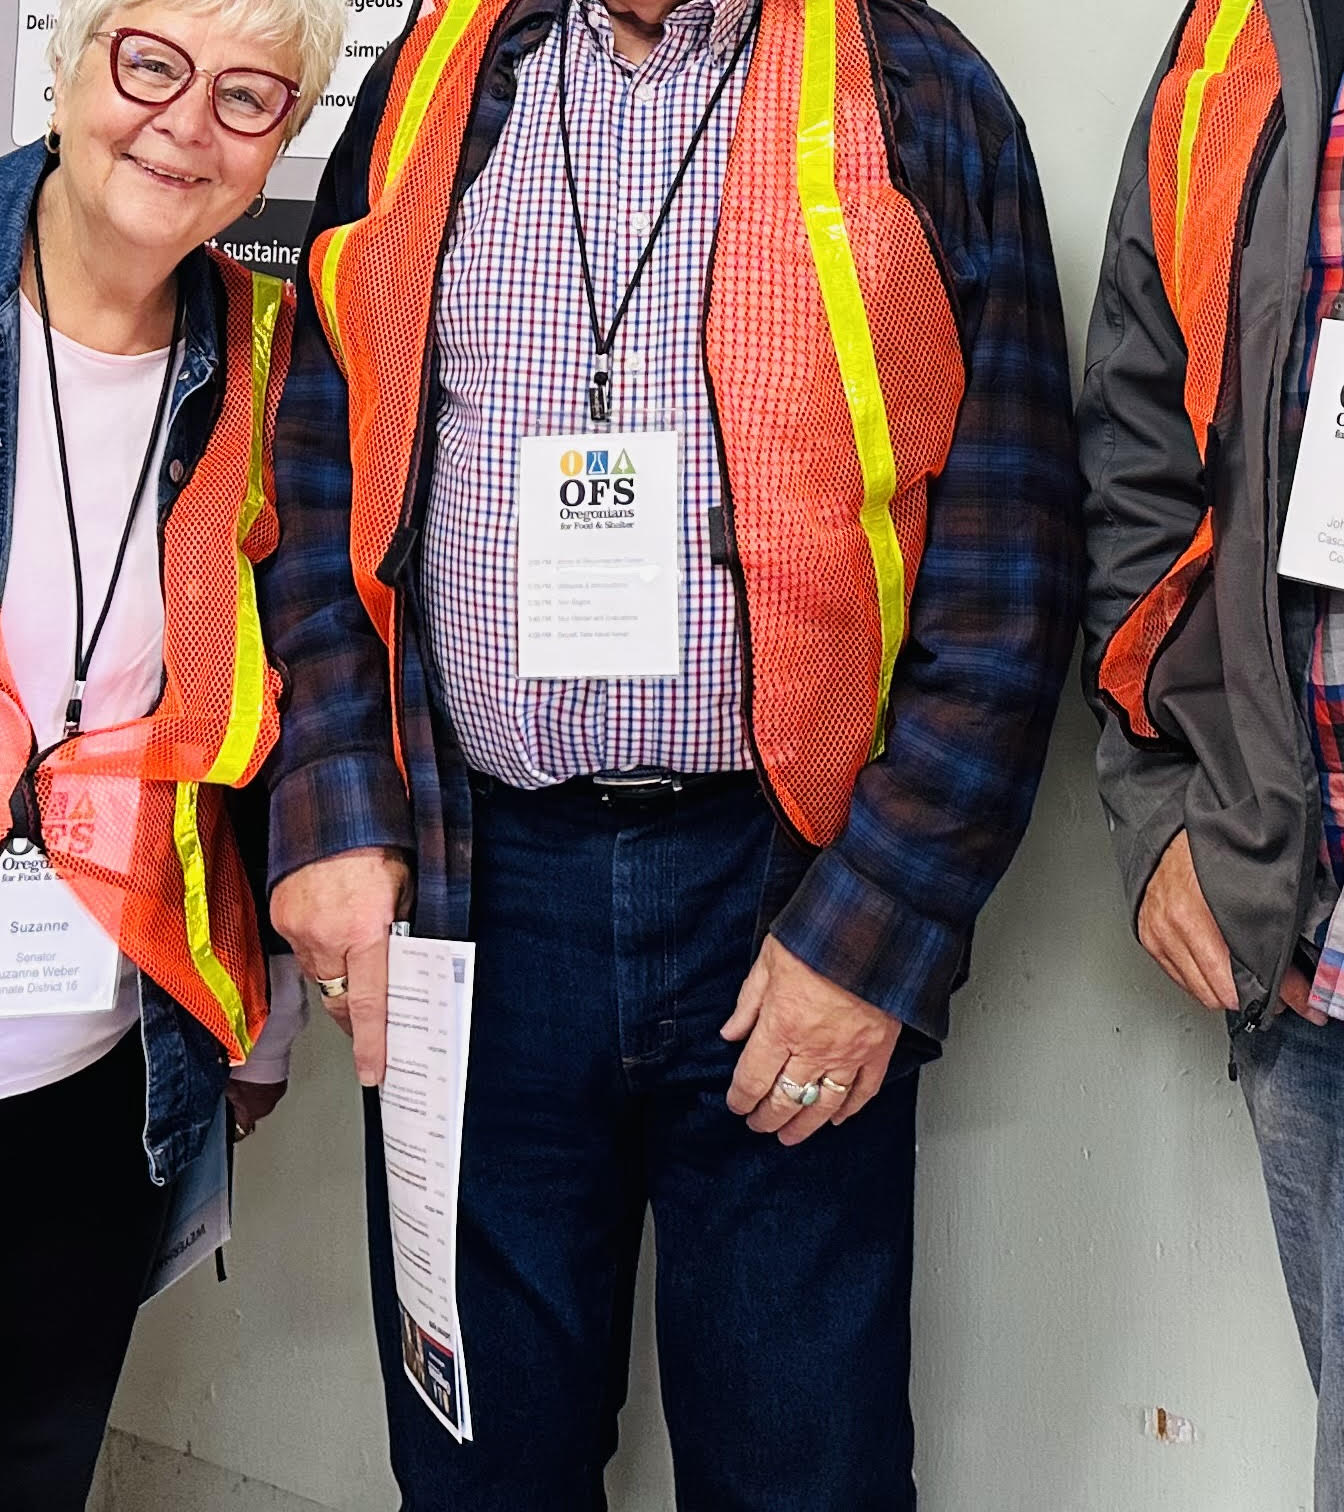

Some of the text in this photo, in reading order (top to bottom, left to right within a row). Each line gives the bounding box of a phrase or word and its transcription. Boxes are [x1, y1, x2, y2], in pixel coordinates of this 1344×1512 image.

[26, 14, 56, 30] Deli
[345, 40, 390, 58] simp
[223, 240, 297, 265] sustaina
[559, 477, 635, 507] OFS
[559, 508, 635, 522] Oregonians
[560, 520, 634, 530] for Food & Shelter
[2, 857, 53, 873] Orego
[18, 872, 42, 882] Food
[10, 920, 70, 934] Suzanne
[16, 951, 56, 963] Senator
[42, 965, 80, 978] Weber
[27, 983, 63, 995] District
[65, 981, 79, 992] 16
